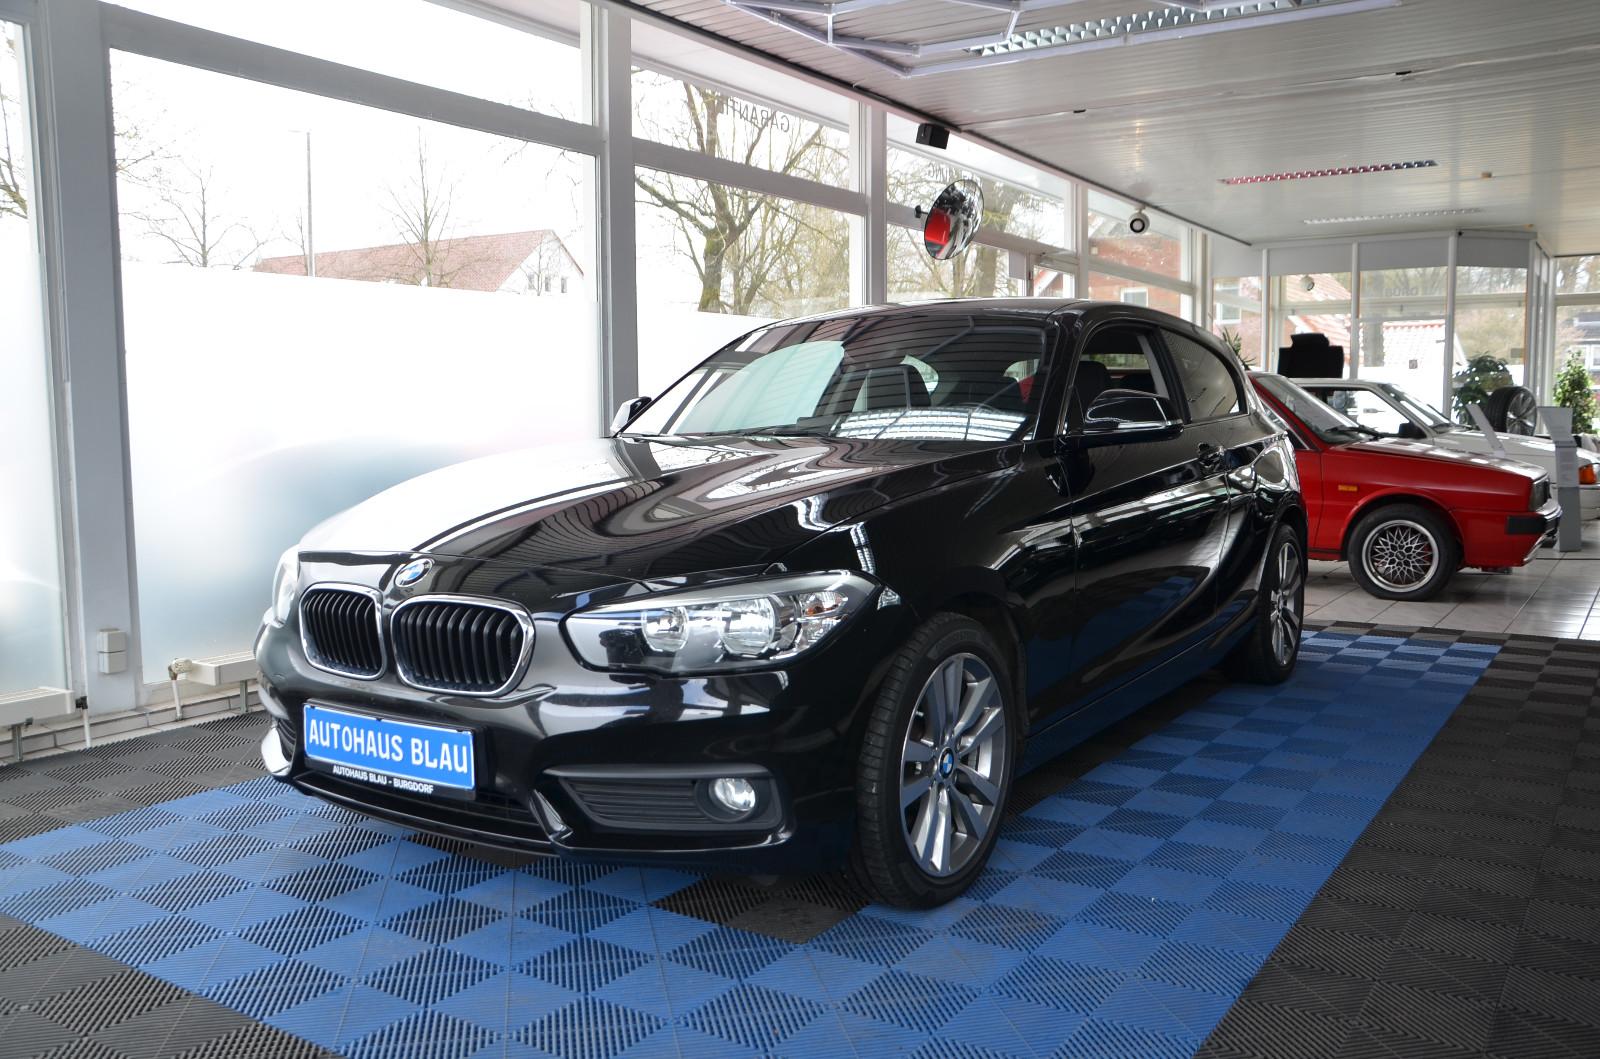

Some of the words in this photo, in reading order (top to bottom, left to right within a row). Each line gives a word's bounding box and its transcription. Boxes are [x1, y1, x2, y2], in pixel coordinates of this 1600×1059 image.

[308, 719, 404, 762] AUTOHAUS
[410, 737, 469, 774] BLAU
[332, 765, 368, 782] AUTOHAUS
[368, 772, 387, 786] BLAU
[393, 777, 434, 795] BURGDORF
